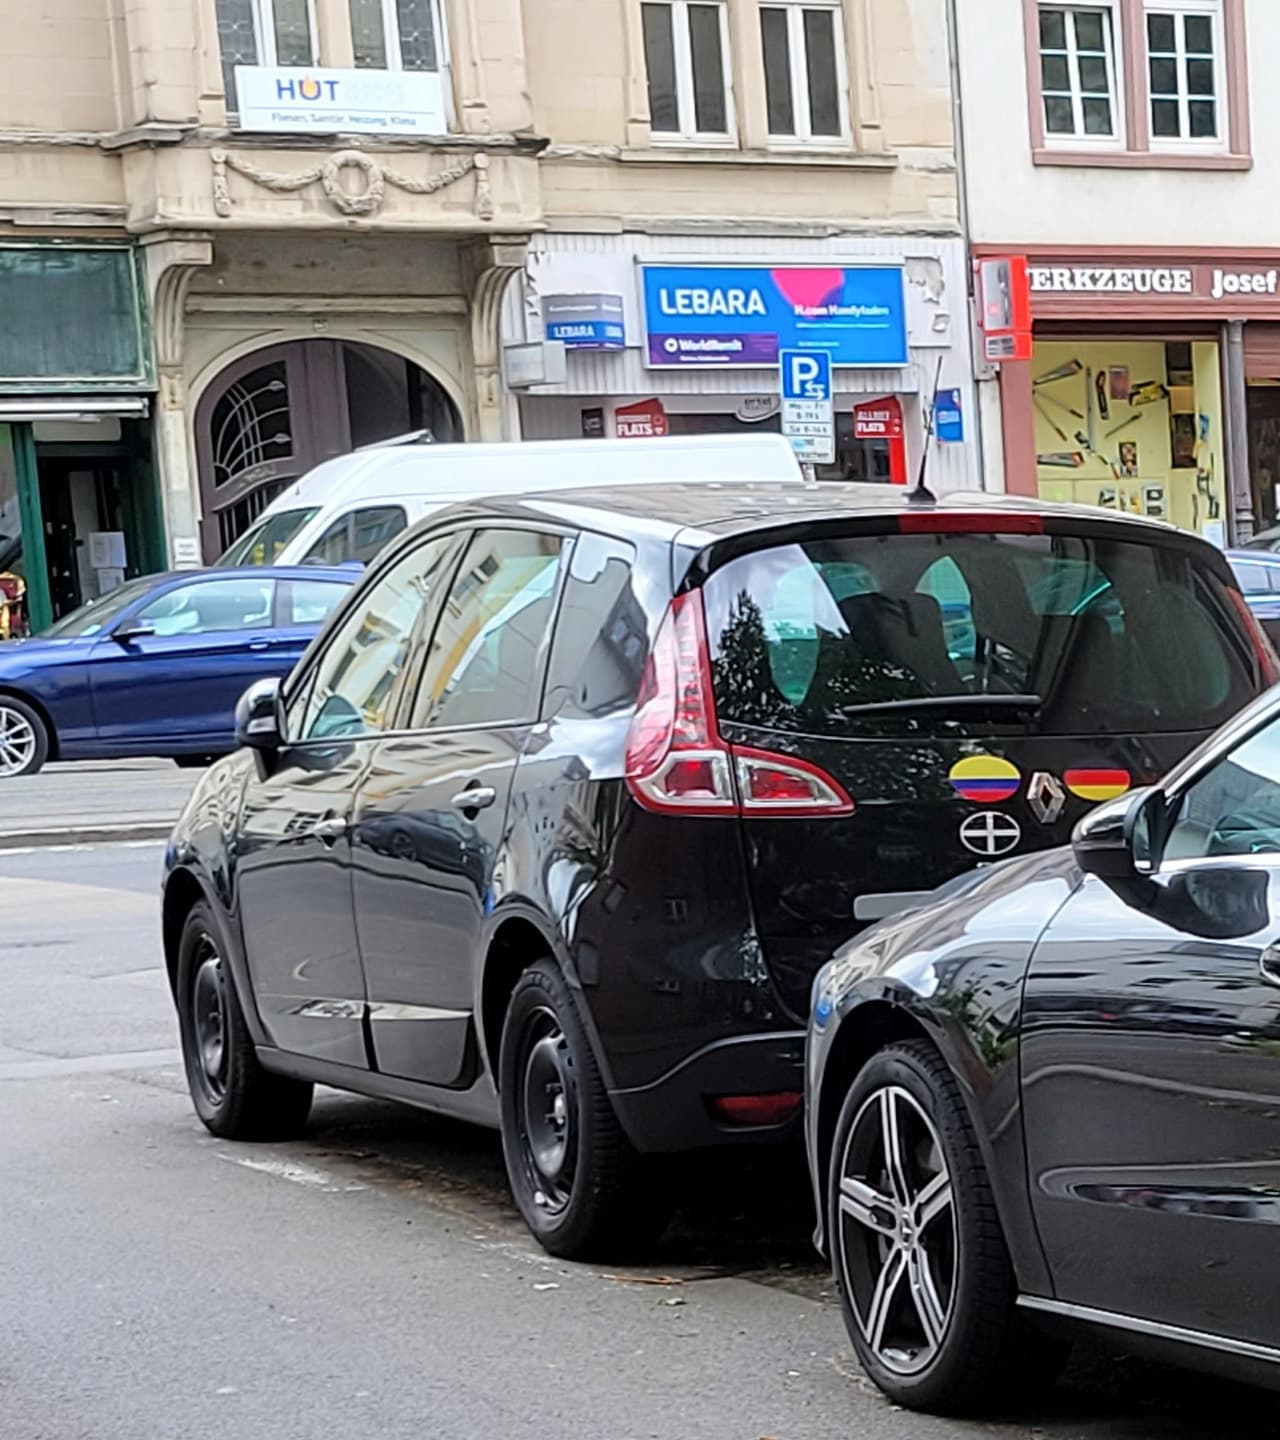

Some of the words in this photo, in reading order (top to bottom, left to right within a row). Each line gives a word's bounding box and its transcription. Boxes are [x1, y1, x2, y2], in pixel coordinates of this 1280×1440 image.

[1025, 268, 1192, 292] ERKZEUGE
[1211, 269, 1277, 298] Josef
[660, 289, 767, 314] LEBARA
[791, 356, 819, 394] P
[617, 423, 652, 436] FLATS
